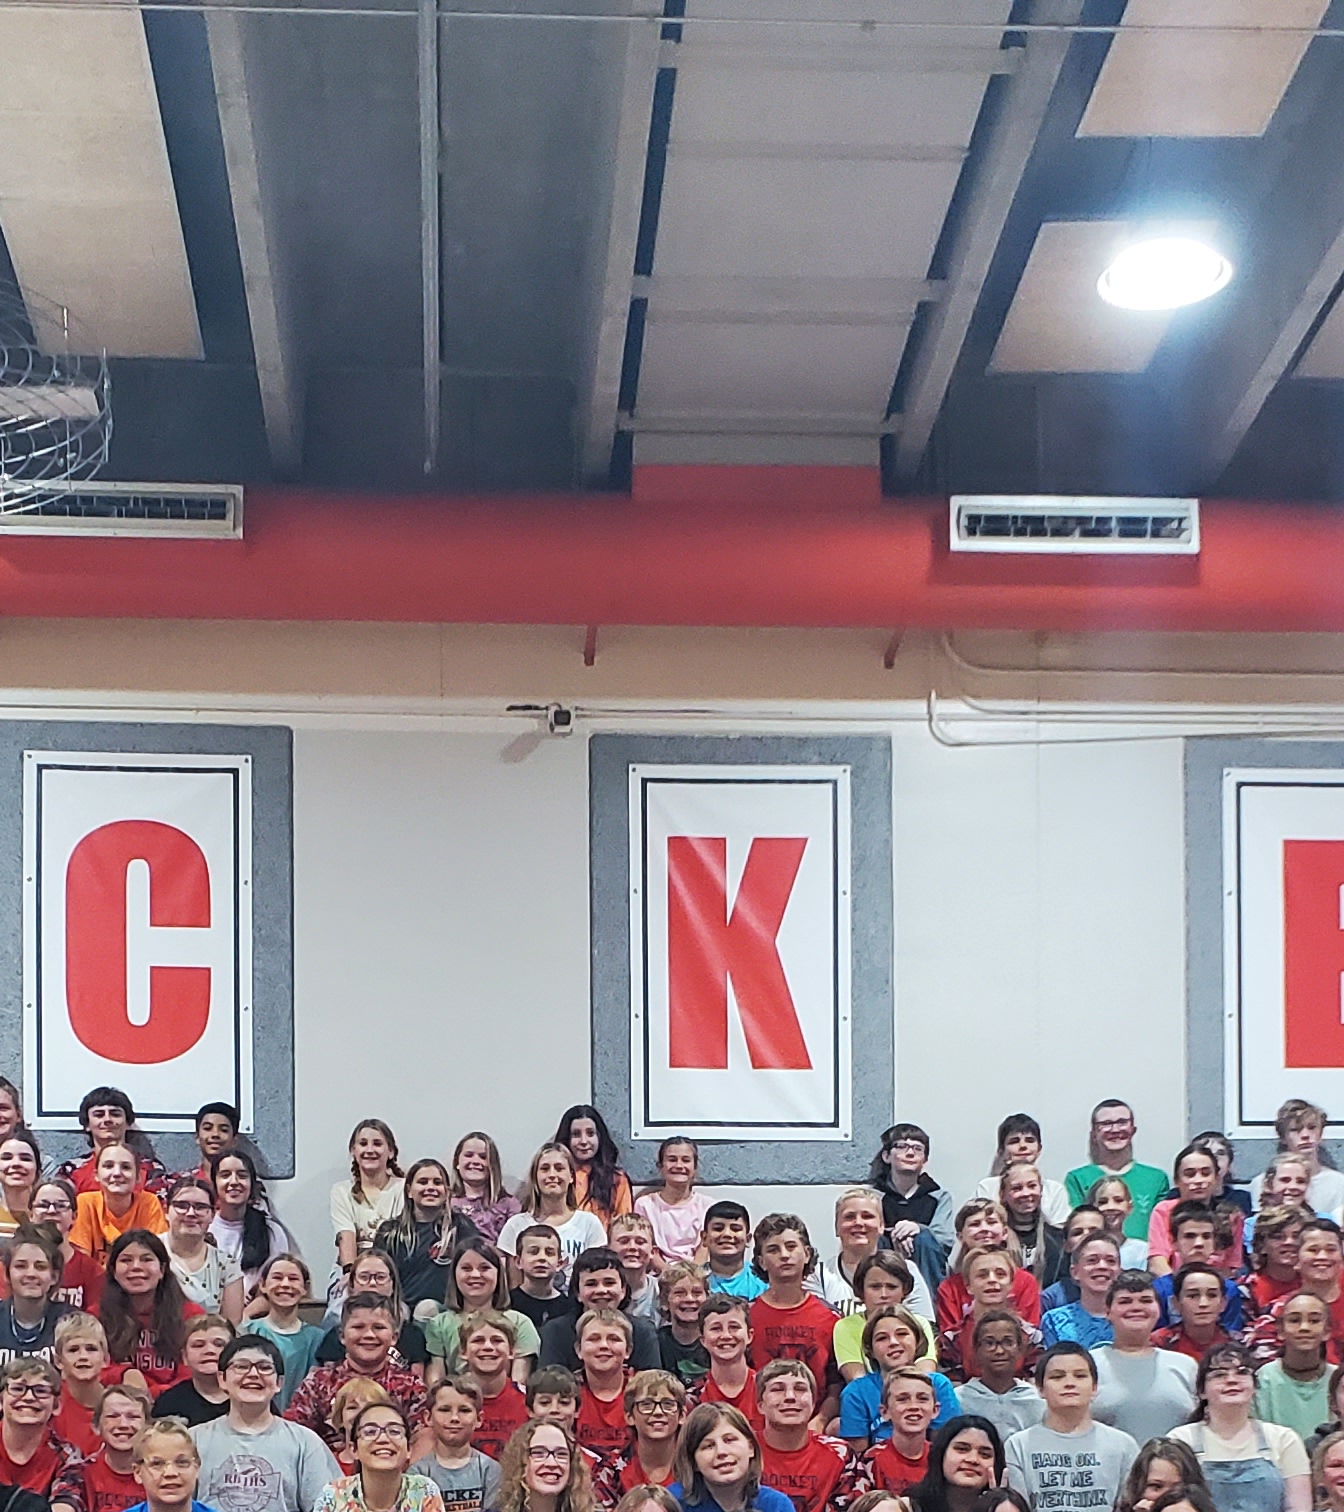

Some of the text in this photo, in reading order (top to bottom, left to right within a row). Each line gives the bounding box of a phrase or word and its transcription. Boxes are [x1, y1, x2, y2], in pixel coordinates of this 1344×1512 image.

[66, 819, 212, 1064] C
[667, 836, 813, 1070] K
[1031, 1453, 1100, 1469] HANG ON.
[1039, 1471, 1093, 1488] LET ME
